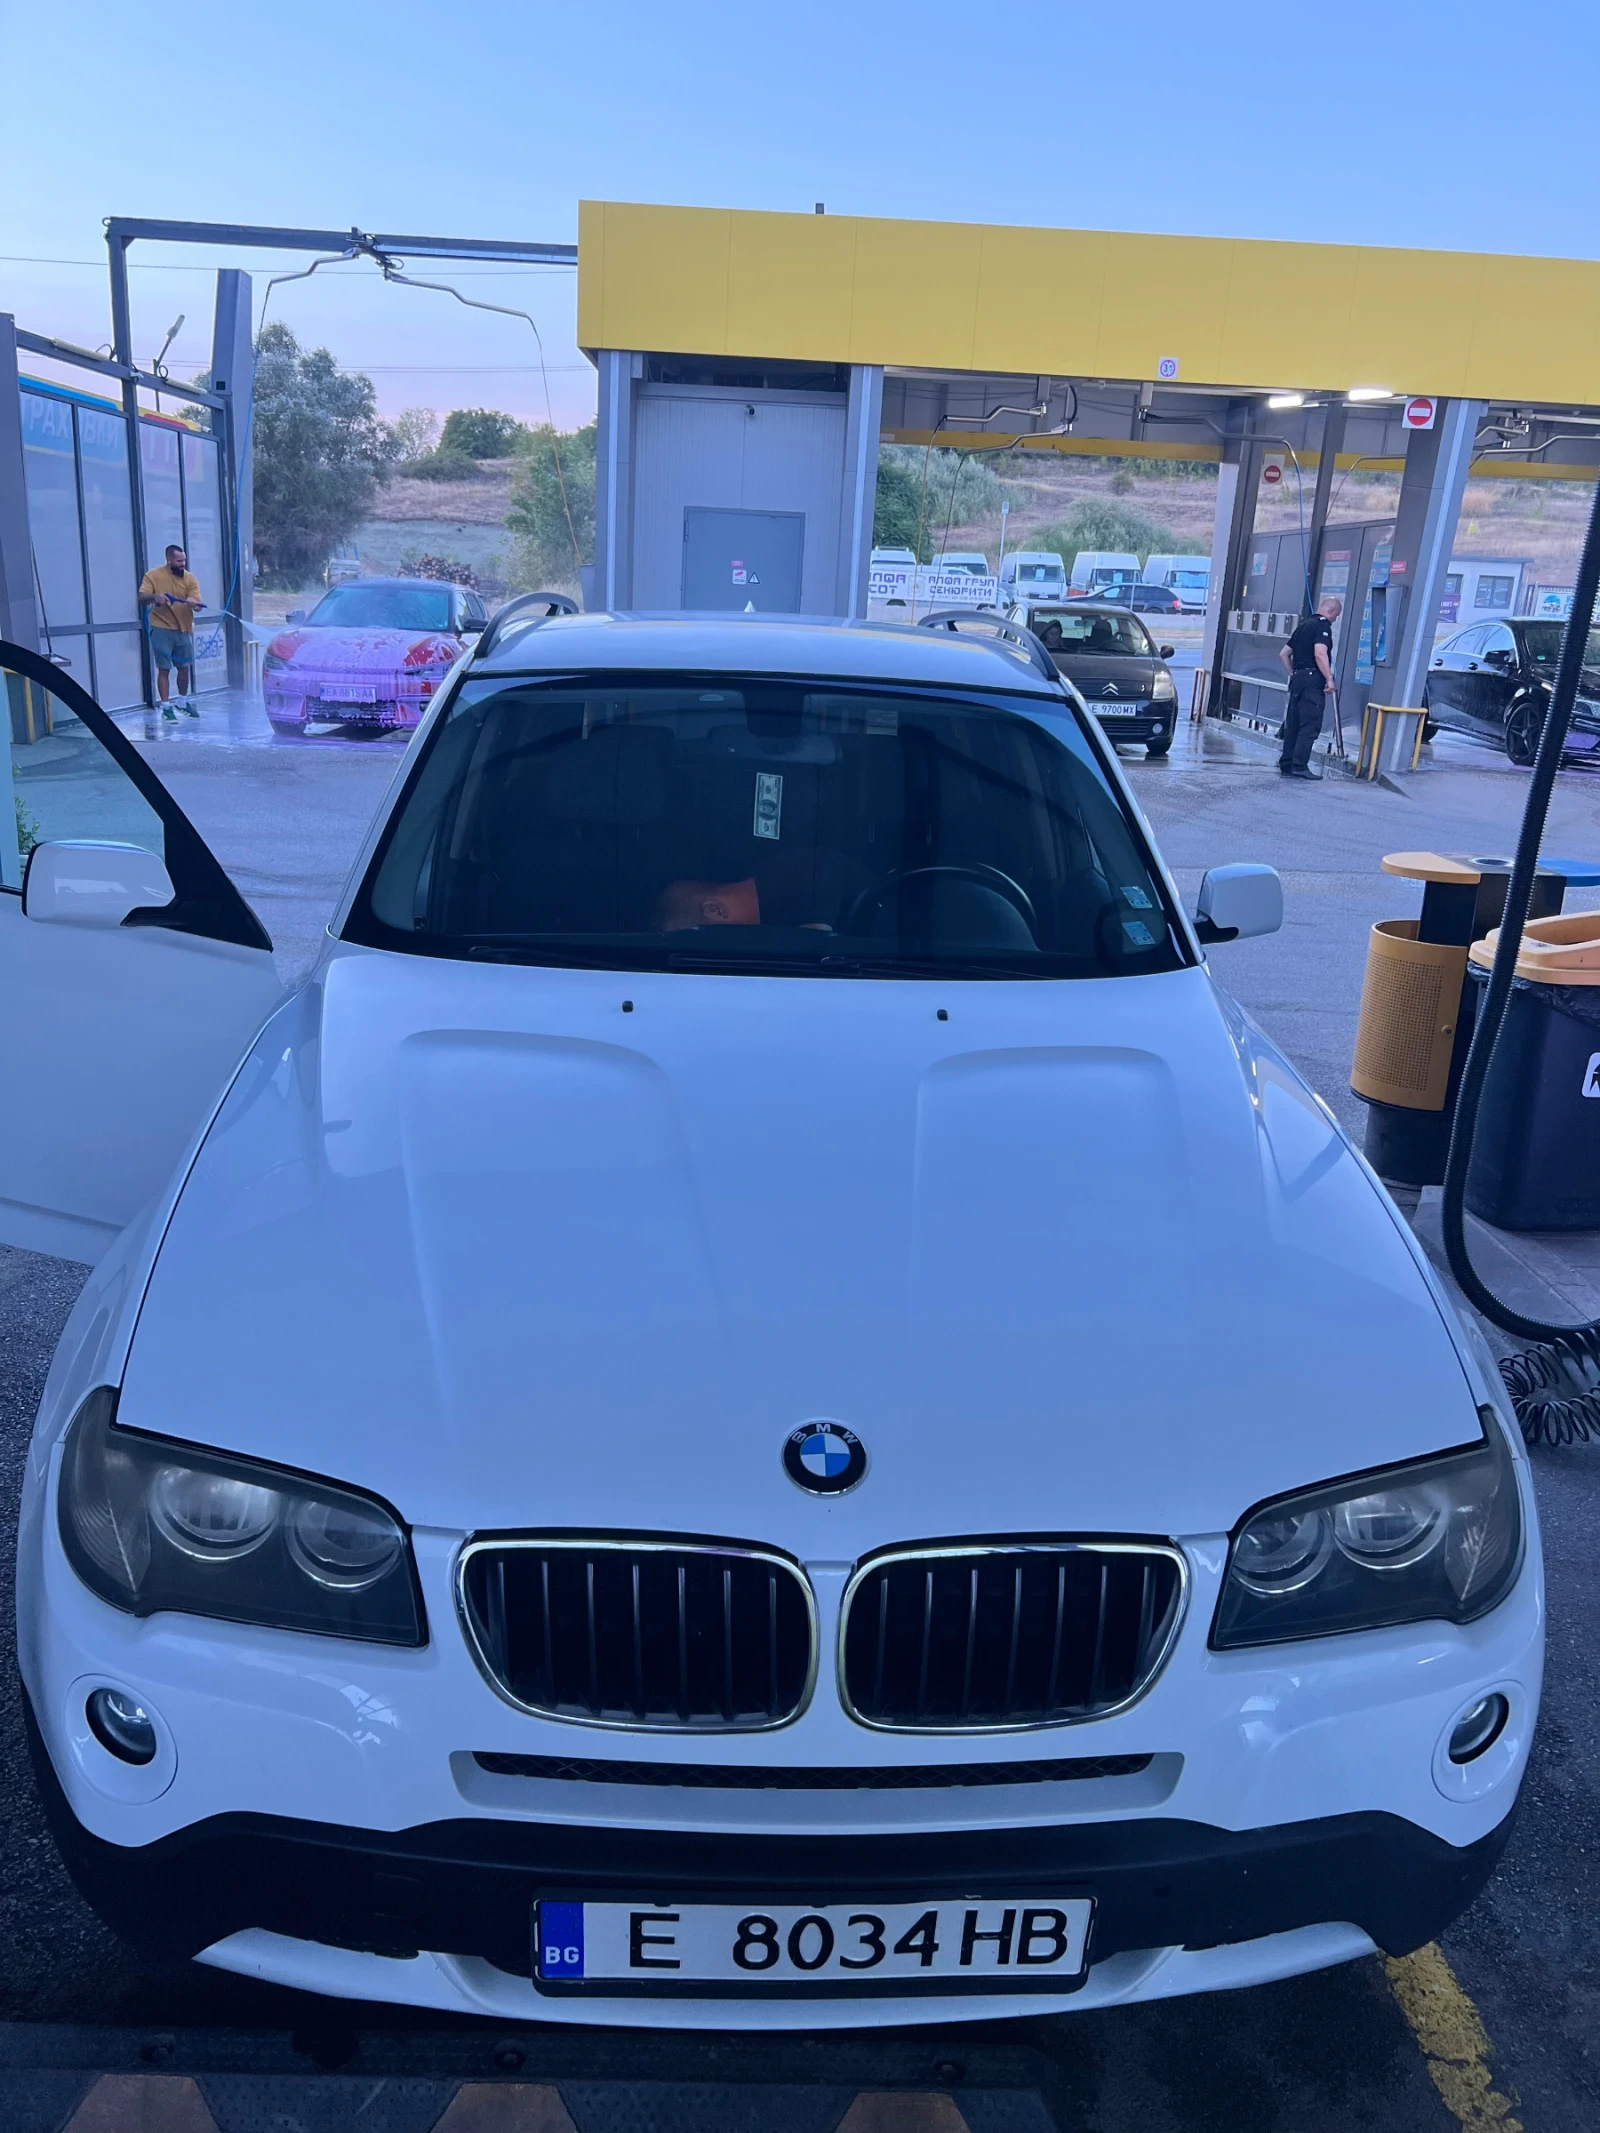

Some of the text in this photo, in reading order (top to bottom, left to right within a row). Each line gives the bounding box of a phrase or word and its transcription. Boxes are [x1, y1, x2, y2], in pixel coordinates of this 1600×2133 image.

[929, 585, 993, 597] СЕКЮРИТИ
[1101, 704, 1123, 715] 9700
[791, 1423, 858, 1444] BMW
[544, 1907, 1070, 1971] BG E 8034 HB
